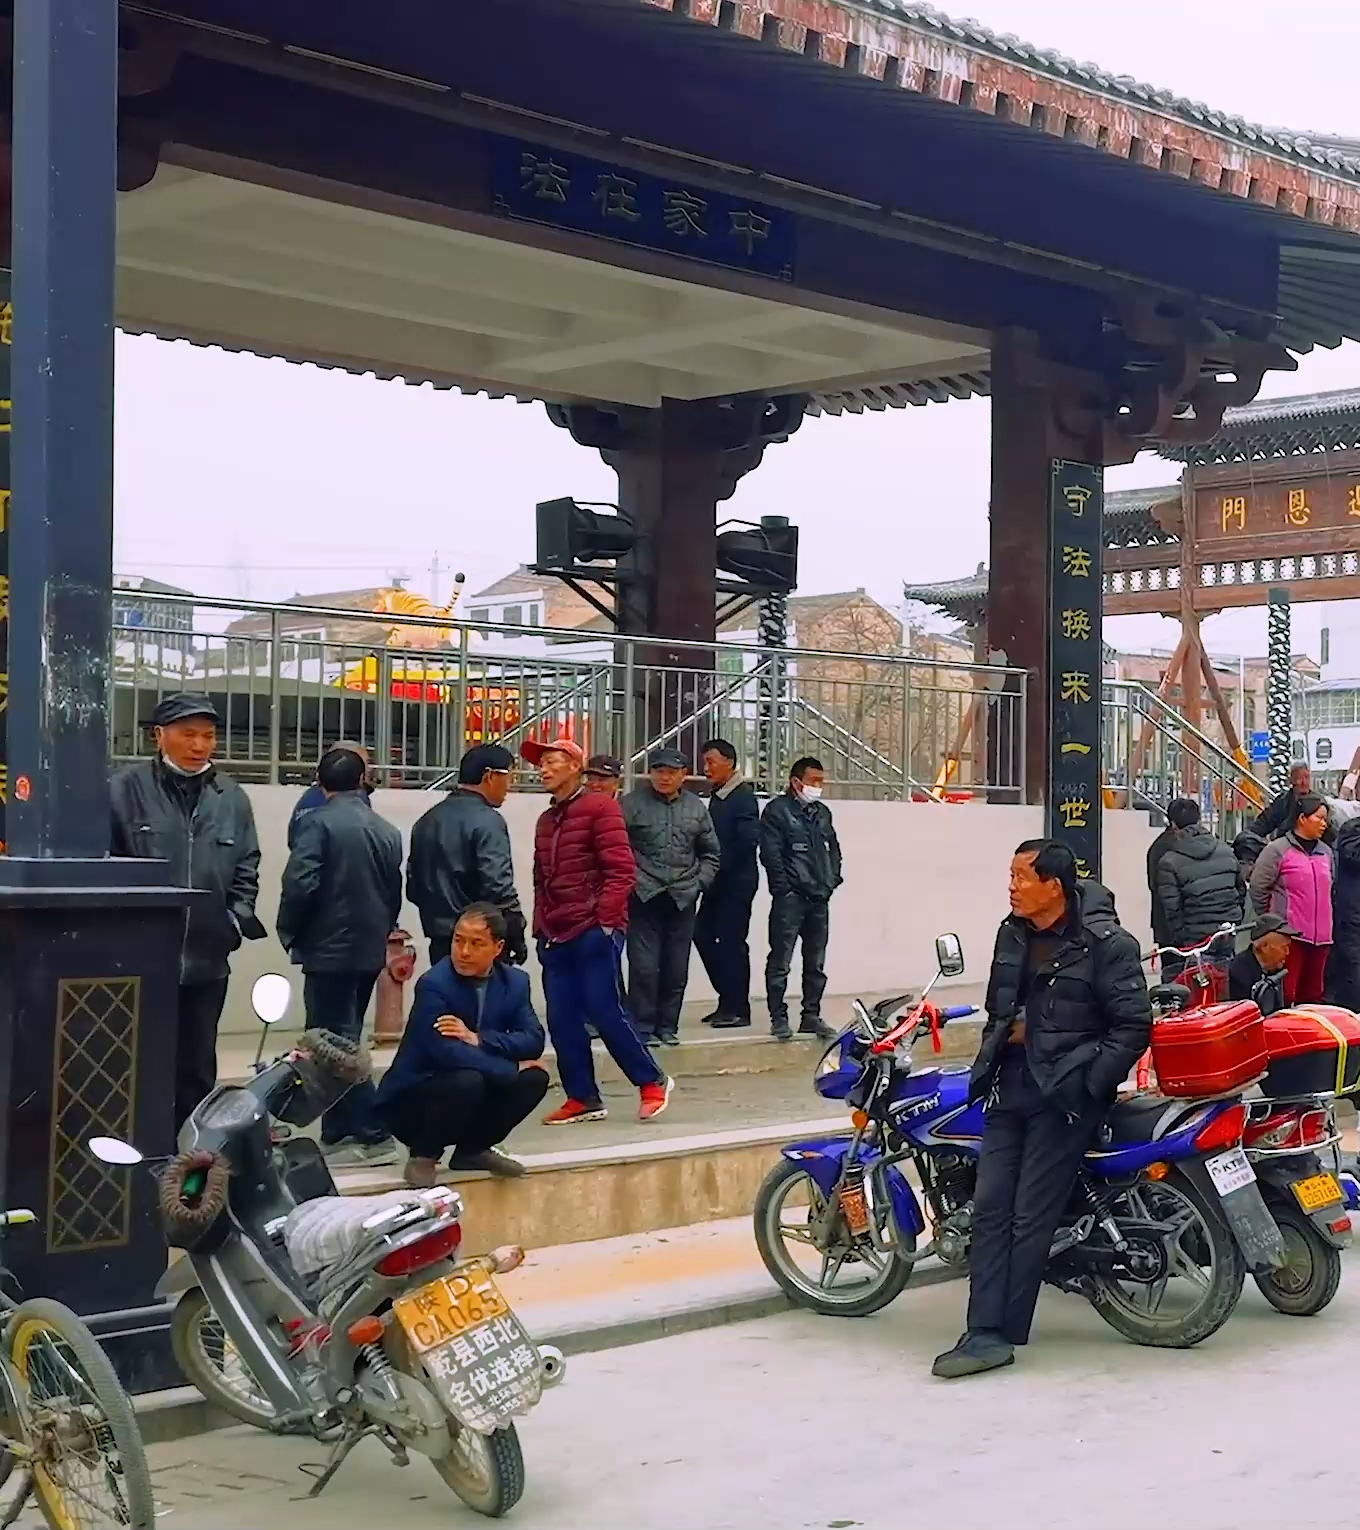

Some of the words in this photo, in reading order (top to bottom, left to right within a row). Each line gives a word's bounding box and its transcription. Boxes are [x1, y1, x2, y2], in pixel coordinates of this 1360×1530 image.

[413, 1288, 500, 1347] CA065
[449, 1344, 536, 1408] 名优选择
